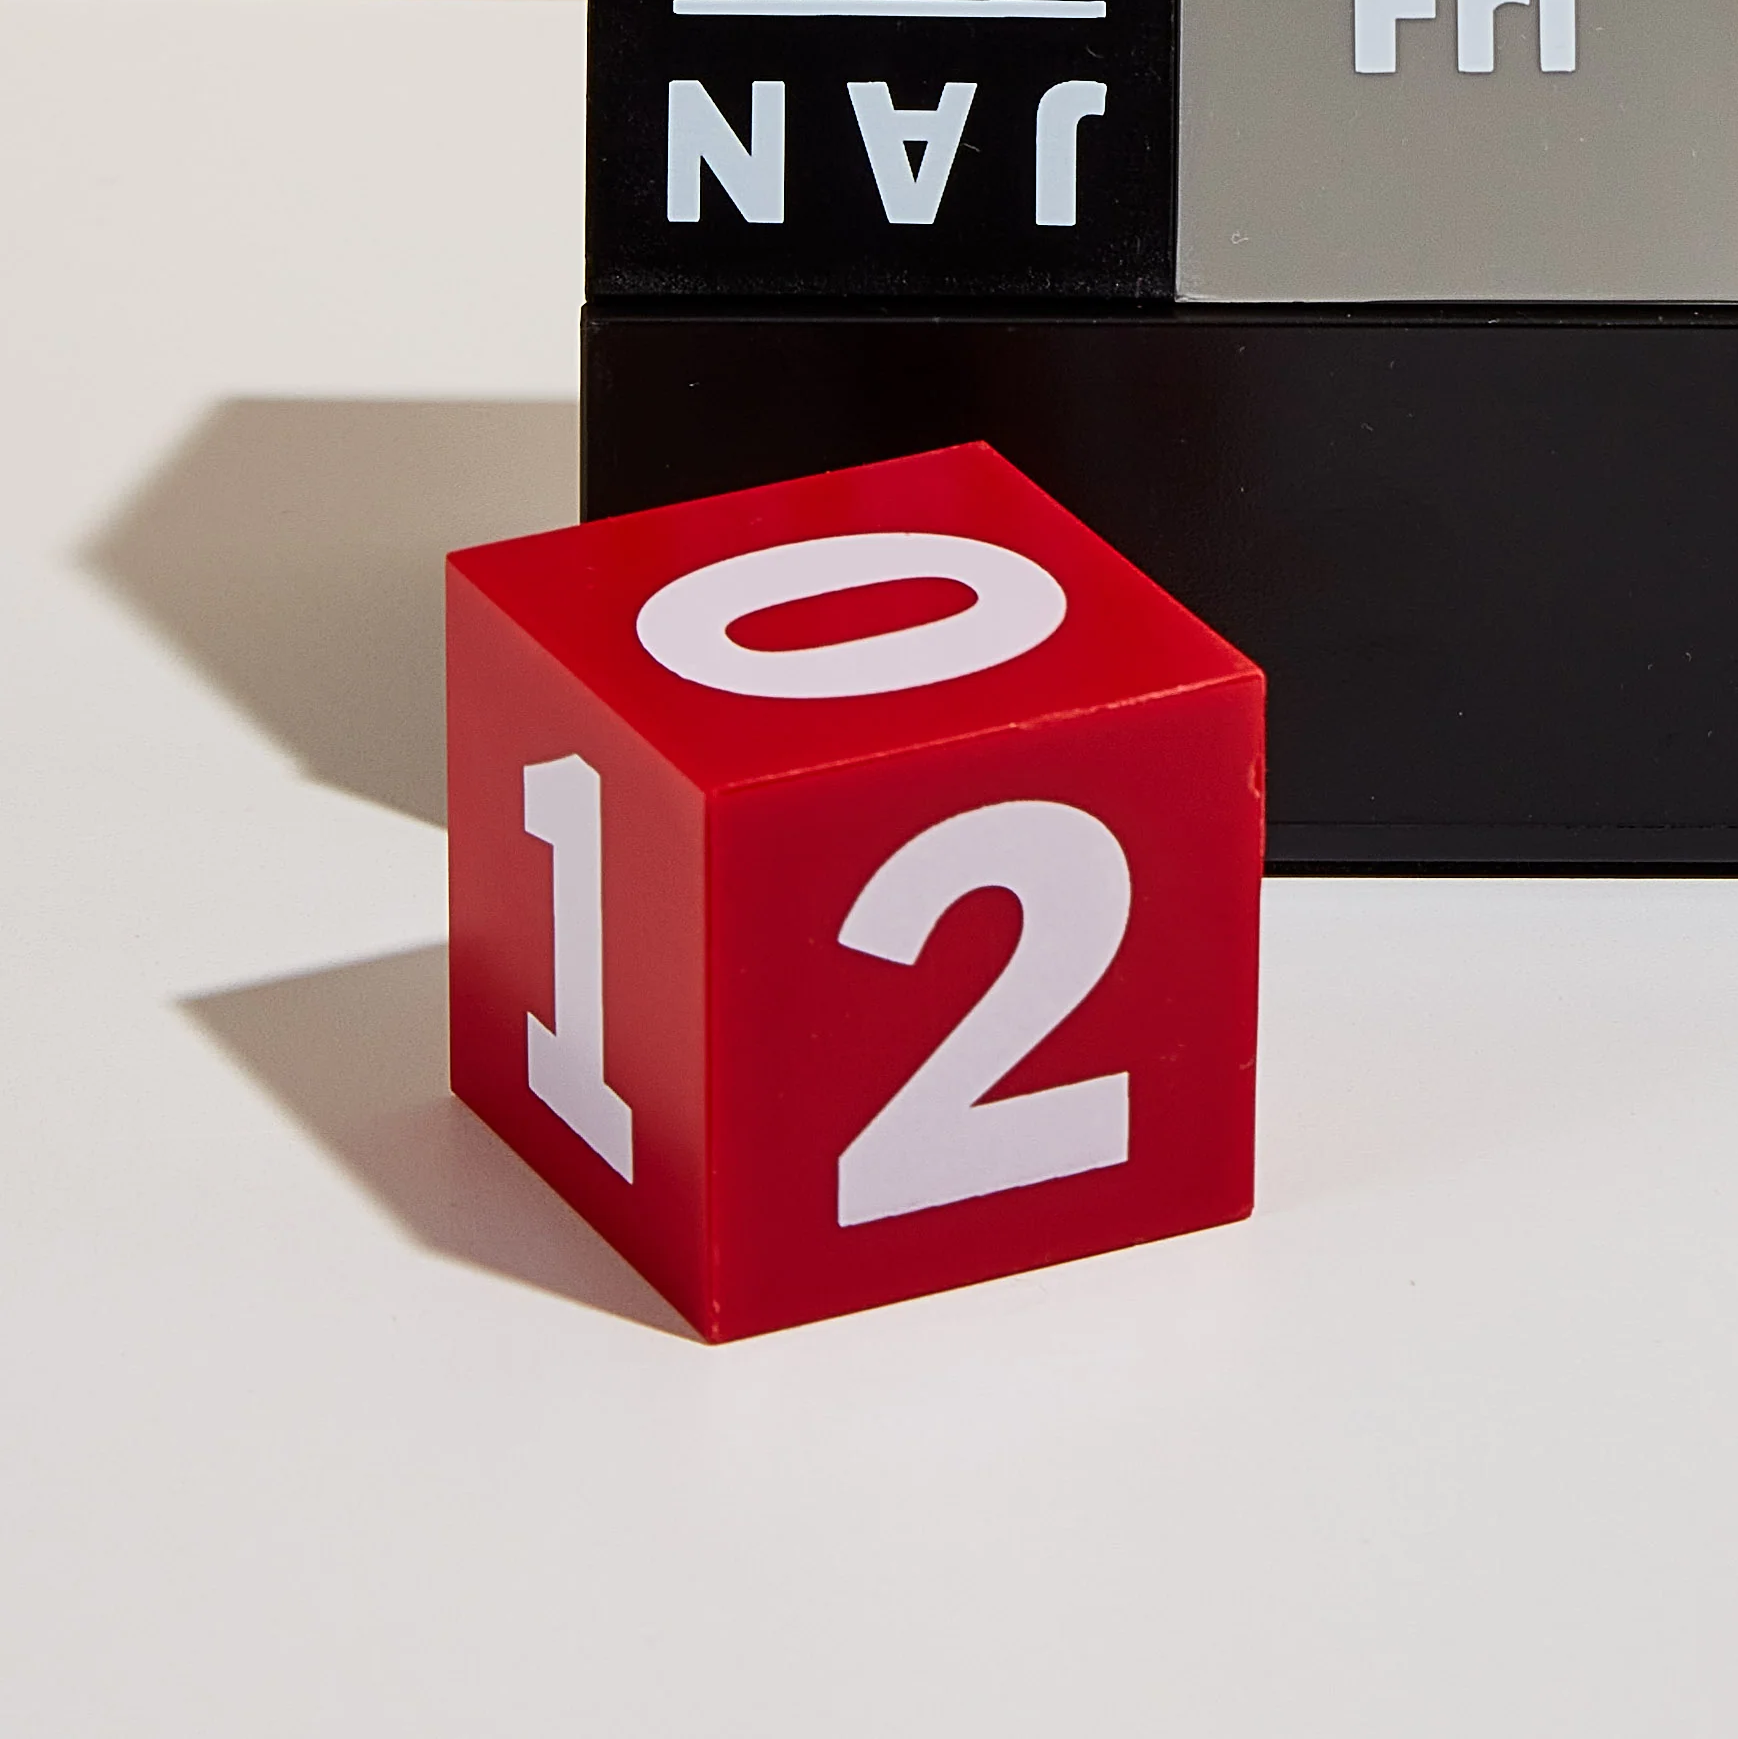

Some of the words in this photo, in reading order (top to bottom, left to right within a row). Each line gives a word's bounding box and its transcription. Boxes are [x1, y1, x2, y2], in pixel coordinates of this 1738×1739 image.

[666, 79, 1108, 227] JAN
[635, 532, 1068, 699] 0
[523, 753, 634, 1185] 1
[837, 799, 1132, 1228] 2
